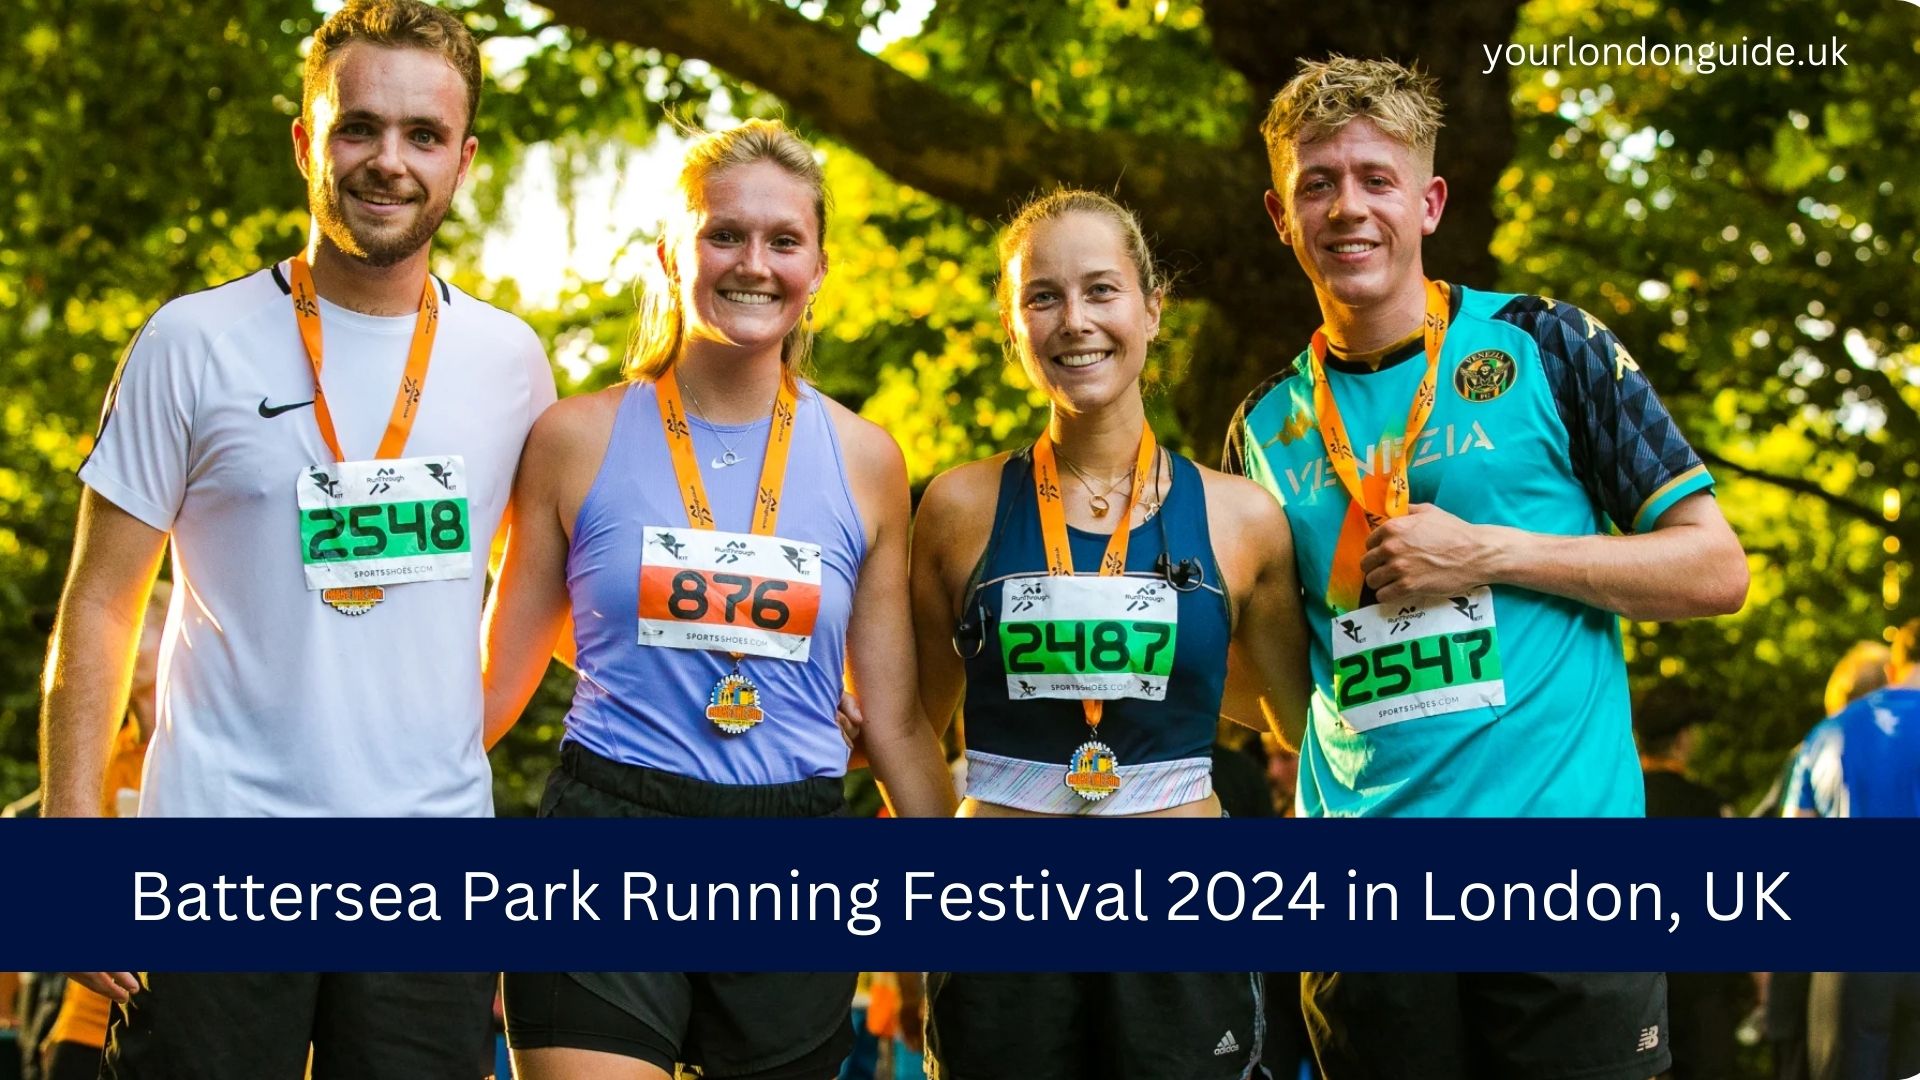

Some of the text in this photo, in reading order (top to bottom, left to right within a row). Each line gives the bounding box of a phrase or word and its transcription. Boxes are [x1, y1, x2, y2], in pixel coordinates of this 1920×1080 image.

[366, 475, 405, 484] RunThrough
[308, 500, 465, 560] 2548
[714, 547, 756, 557] RunThrough
[354, 565, 433, 578] SPORTSSHOES.COM
[668, 570, 790, 630] 876
[1011, 594, 1051, 602] RunThrough
[1125, 594, 1166, 603] RunThrough
[1388, 611, 1426, 624] RunThrough
[686, 632, 768, 648] SPORTSSHOES.COM
[1007, 621, 1171, 673] 2487
[1339, 628, 1492, 707] 2547
[1379, 696, 1459, 718] SPORTSSHOES.COM
[1214, 1044, 1239, 1056] adidas
